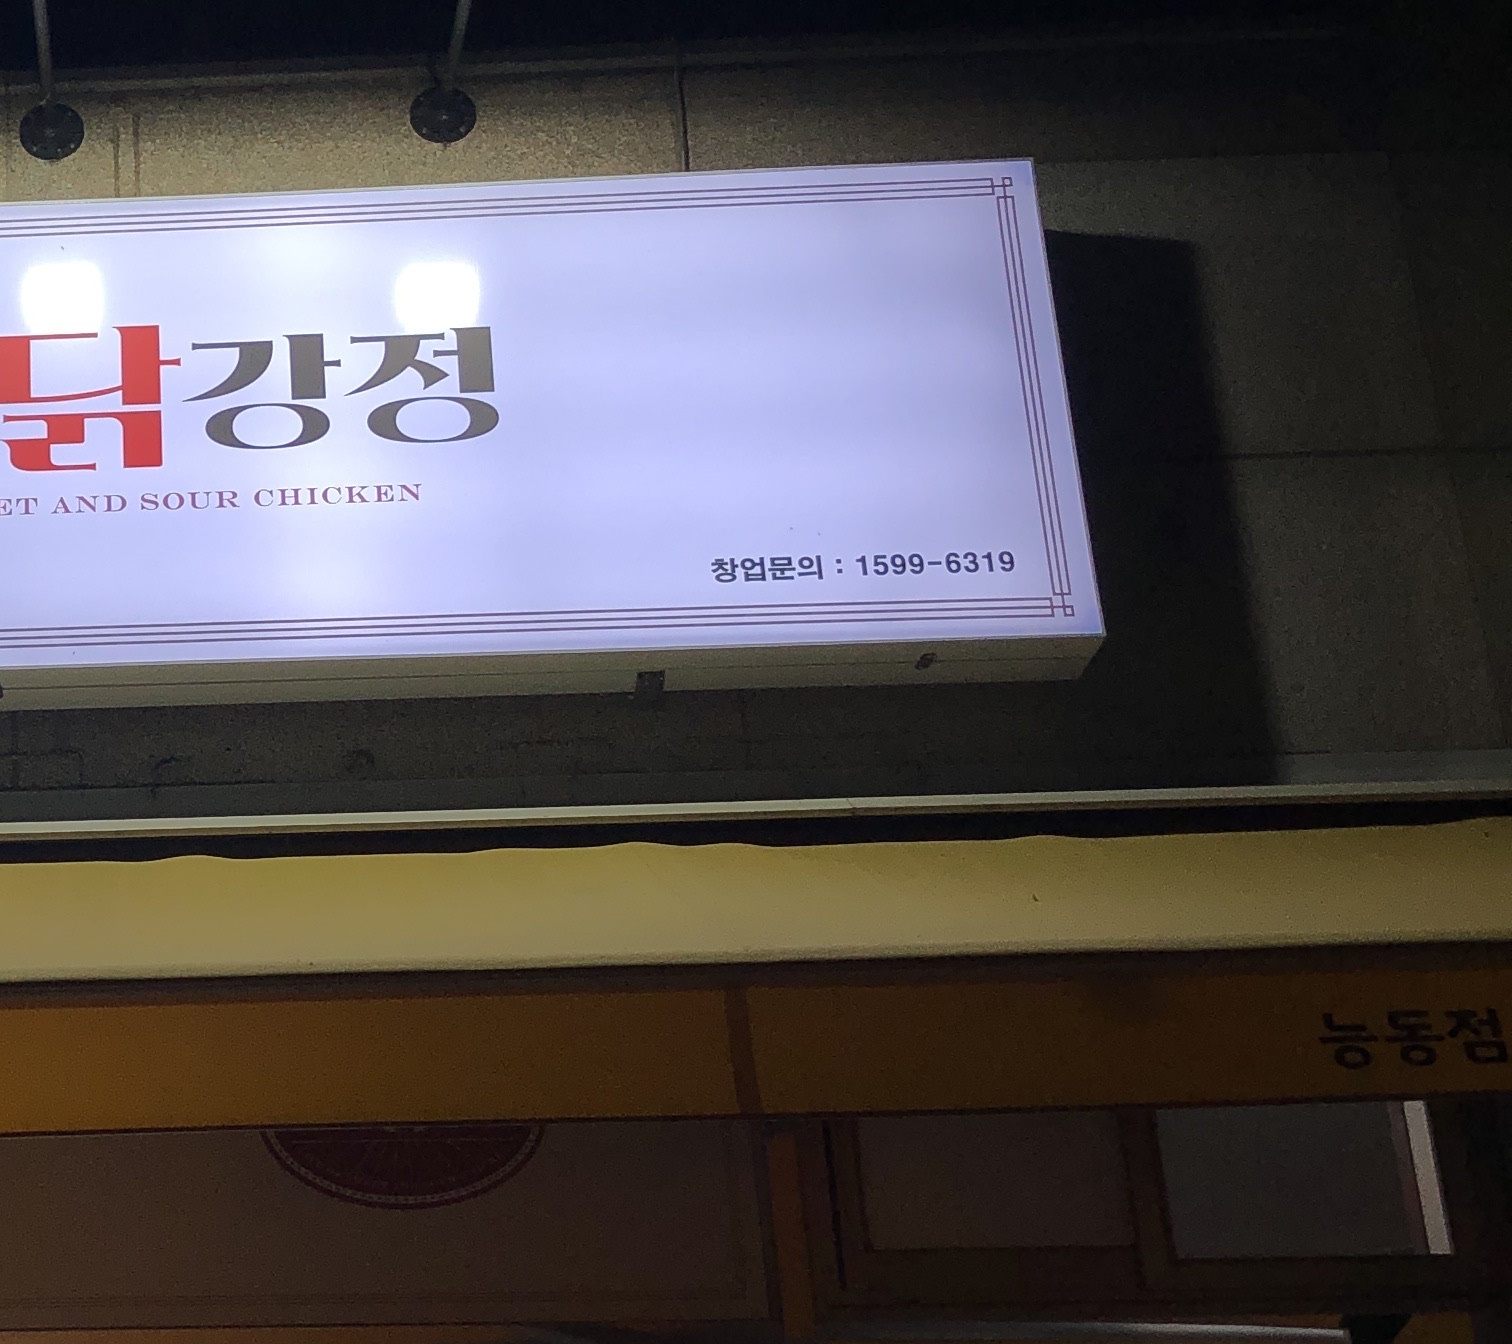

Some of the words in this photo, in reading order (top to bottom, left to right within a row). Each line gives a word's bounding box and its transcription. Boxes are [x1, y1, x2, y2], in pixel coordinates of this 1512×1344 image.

[51, 494, 128, 515] AND
[140, 490, 240, 512] SOUR
[254, 483, 423, 508] CHICKEN
[711, 555, 824, 583] 창업문의
[855, 550, 1016, 576] 1599-6319
[1319, 1008, 1508, 1070] 능동점
